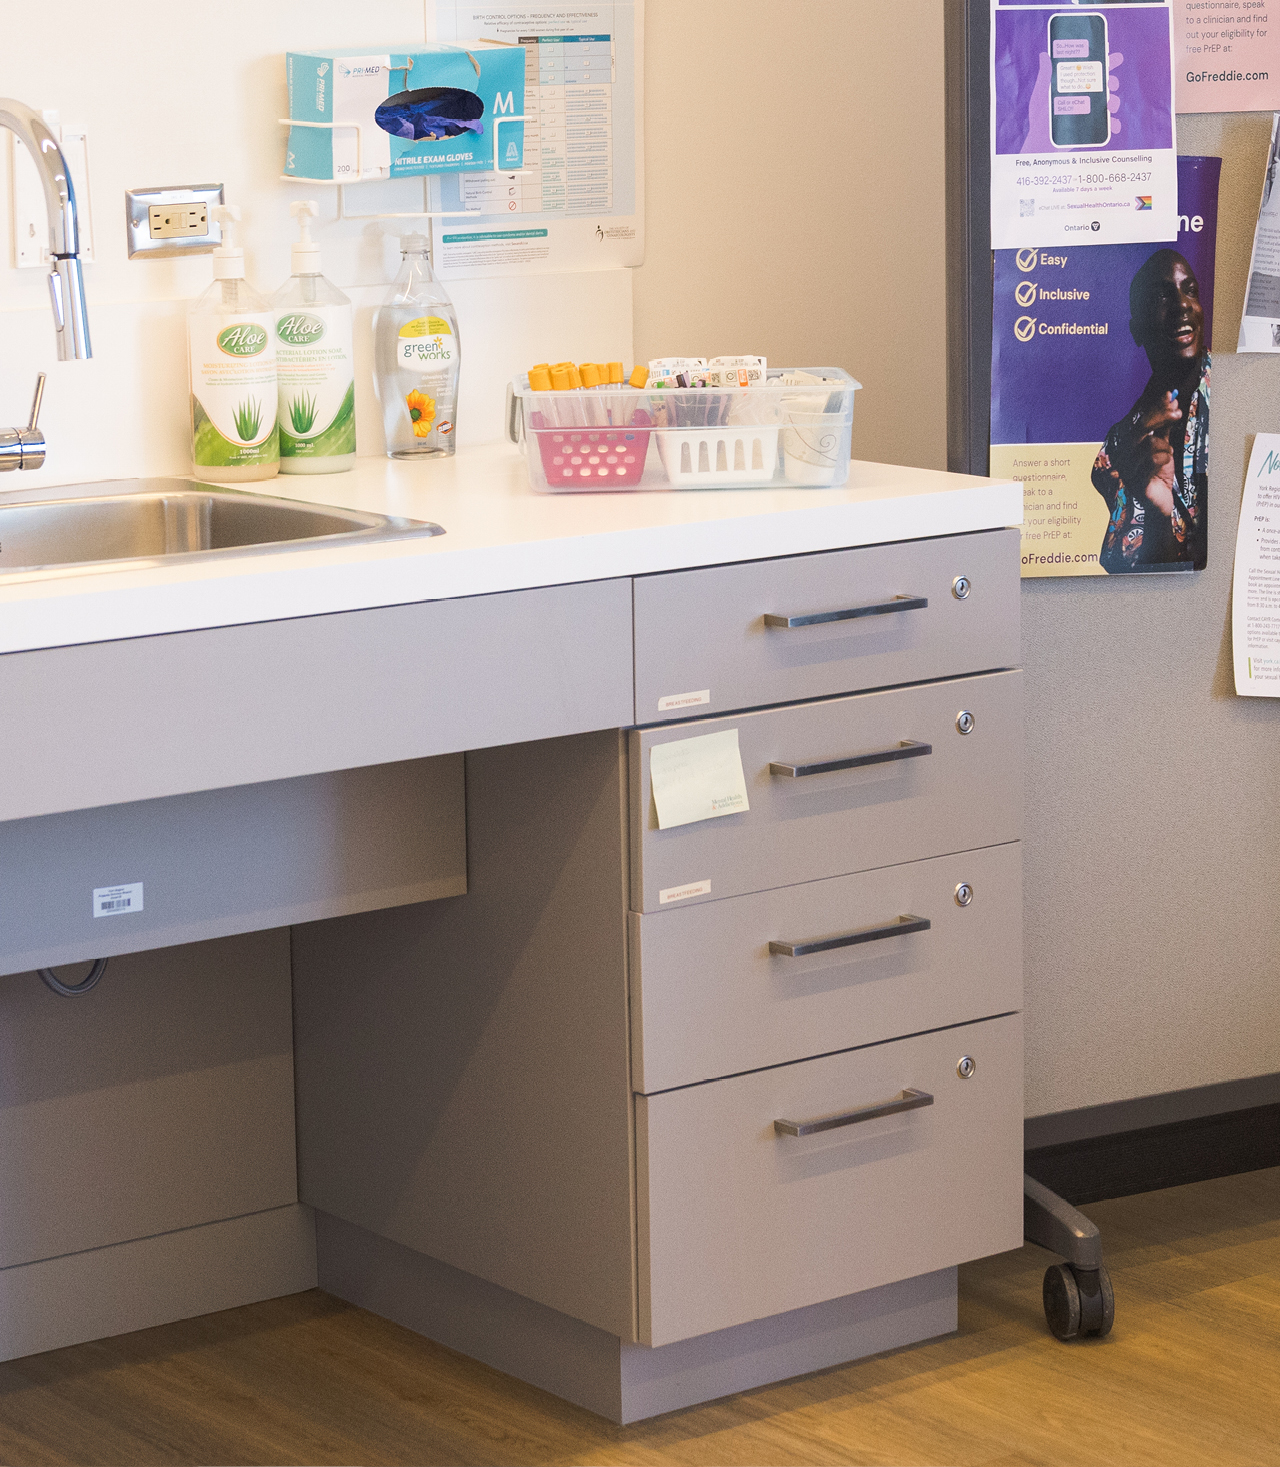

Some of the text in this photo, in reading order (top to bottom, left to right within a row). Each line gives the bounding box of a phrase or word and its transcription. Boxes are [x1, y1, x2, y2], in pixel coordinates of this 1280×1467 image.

[1243, 1, 1265, 10] speak
[1203, 15, 1234, 23] clinician
[1237, 15, 1251, 23] and
[1253, 14, 1267, 22] find
[1201, 32, 1218, 40] your
[1221, 30, 1254, 40] eligibility
[1256, 29, 1267, 37] for
[1186, 45, 1201, 53] free
[1204, 44, 1221, 52] PrEP
[1186, 70, 1268, 82] GoFreddie.com
[493, 91, 514, 114] M
[395, 156, 422, 166] NITRILE
[424, 155, 445, 164] EXAM
[1033, 158, 1070, 166] Anonymous
[1080, 156, 1110, 164] Inclusive
[1112, 155, 1152, 163] Counselling
[1017, 172, 1152, 186] 416-392-2437 1-800-668-2437
[1067, 202, 1130, 210] SexualHealthOntario.ca
[1178, 215, 1204, 232] ne
[1040, 253, 1067, 268] Easy
[1039, 288, 1090, 300] Inclusive
[279, 316, 323, 336] Aloe
[1039, 323, 1108, 335] Confidential
[222, 327, 266, 347] Aloe
[404, 343, 438, 357] green
[418, 348, 451, 361] works
[1013, 459, 1041, 467] Answer
[1051, 458, 1070, 466] short
[1013, 473, 1067, 481] questionnaire,
[1023, 488, 1036, 496] eak
[1023, 501, 1078, 510] nician and find
[1028, 518, 1045, 527] your
[1048, 516, 1081, 526] eligibility
[1025, 532, 1041, 540] free
[1043, 531, 1061, 539] PrEP
[1063, 531, 1072, 539] at:
[1022, 552, 1098, 565] oFreddie.com
